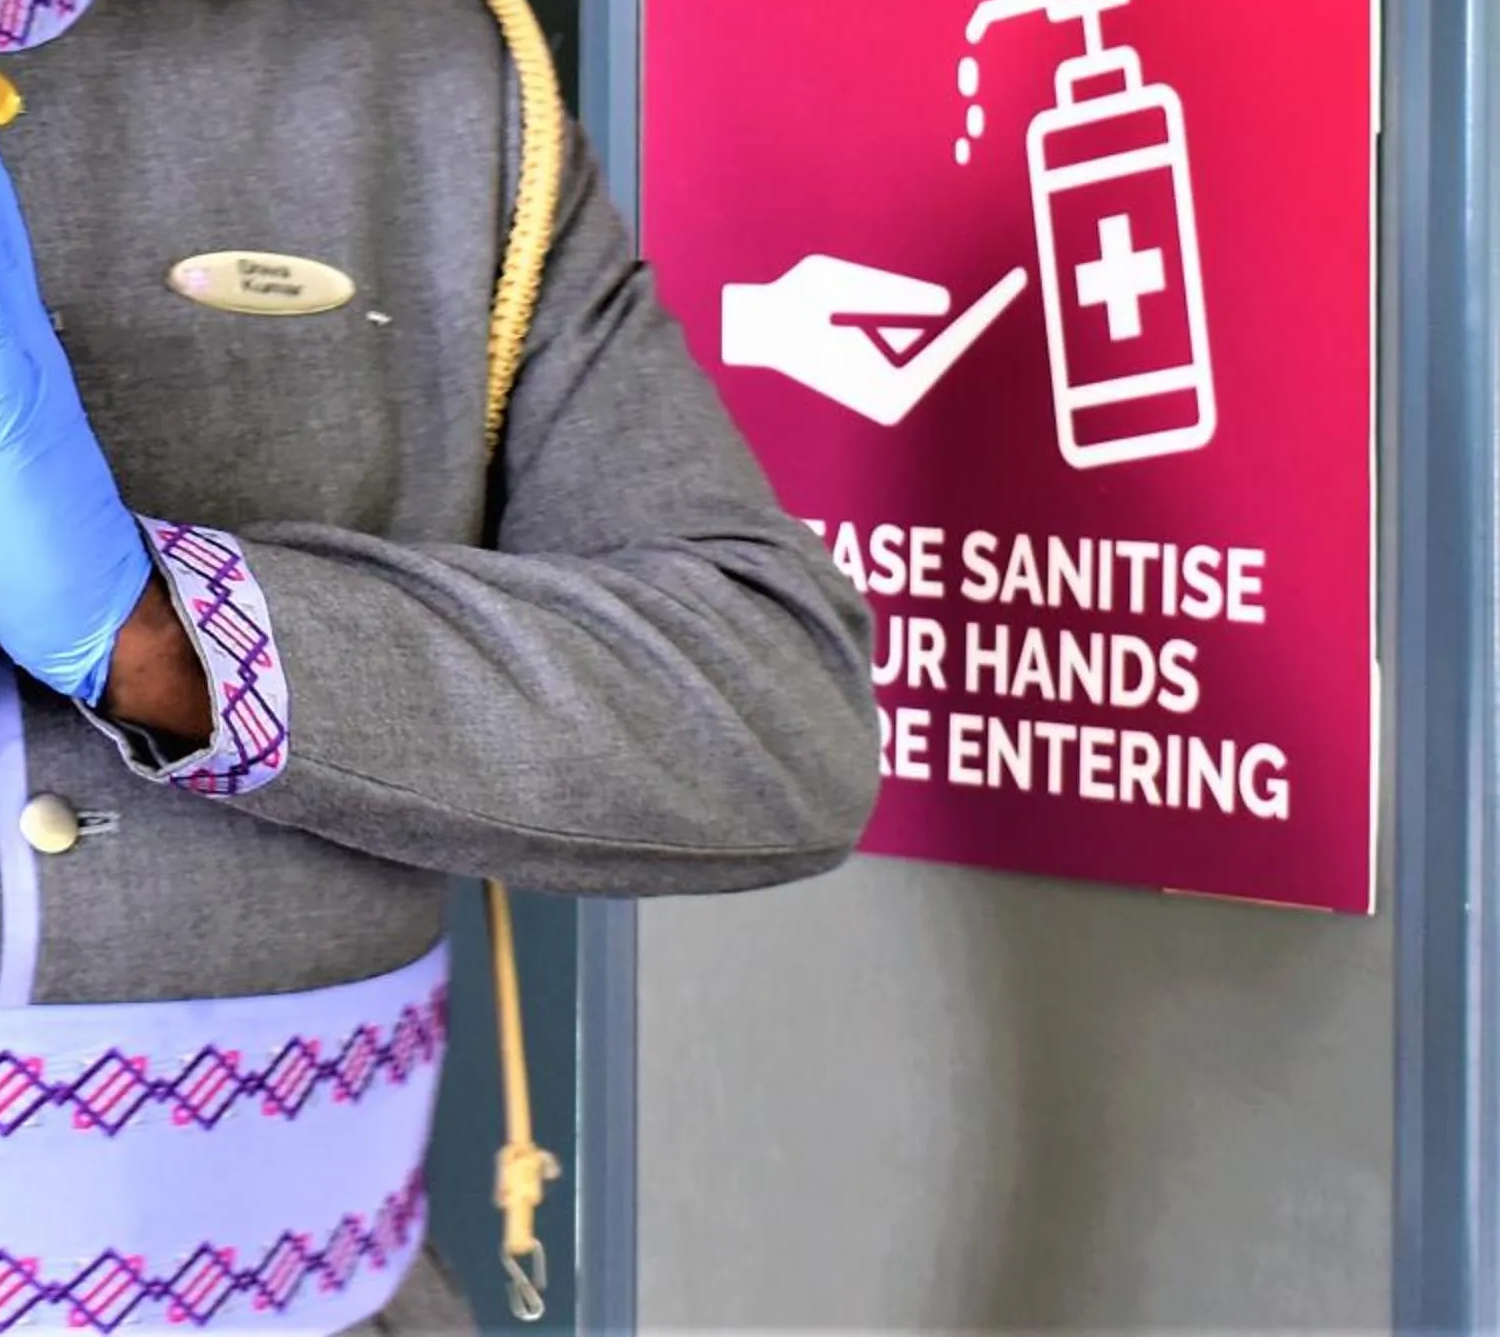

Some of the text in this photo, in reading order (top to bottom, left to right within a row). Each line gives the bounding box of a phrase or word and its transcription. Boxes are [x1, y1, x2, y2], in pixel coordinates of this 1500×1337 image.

[802, 519, 1266, 623] ASE SANITISE
[869, 615, 1200, 713] UR HANDS
[947, 712, 1290, 820] ENTERING
